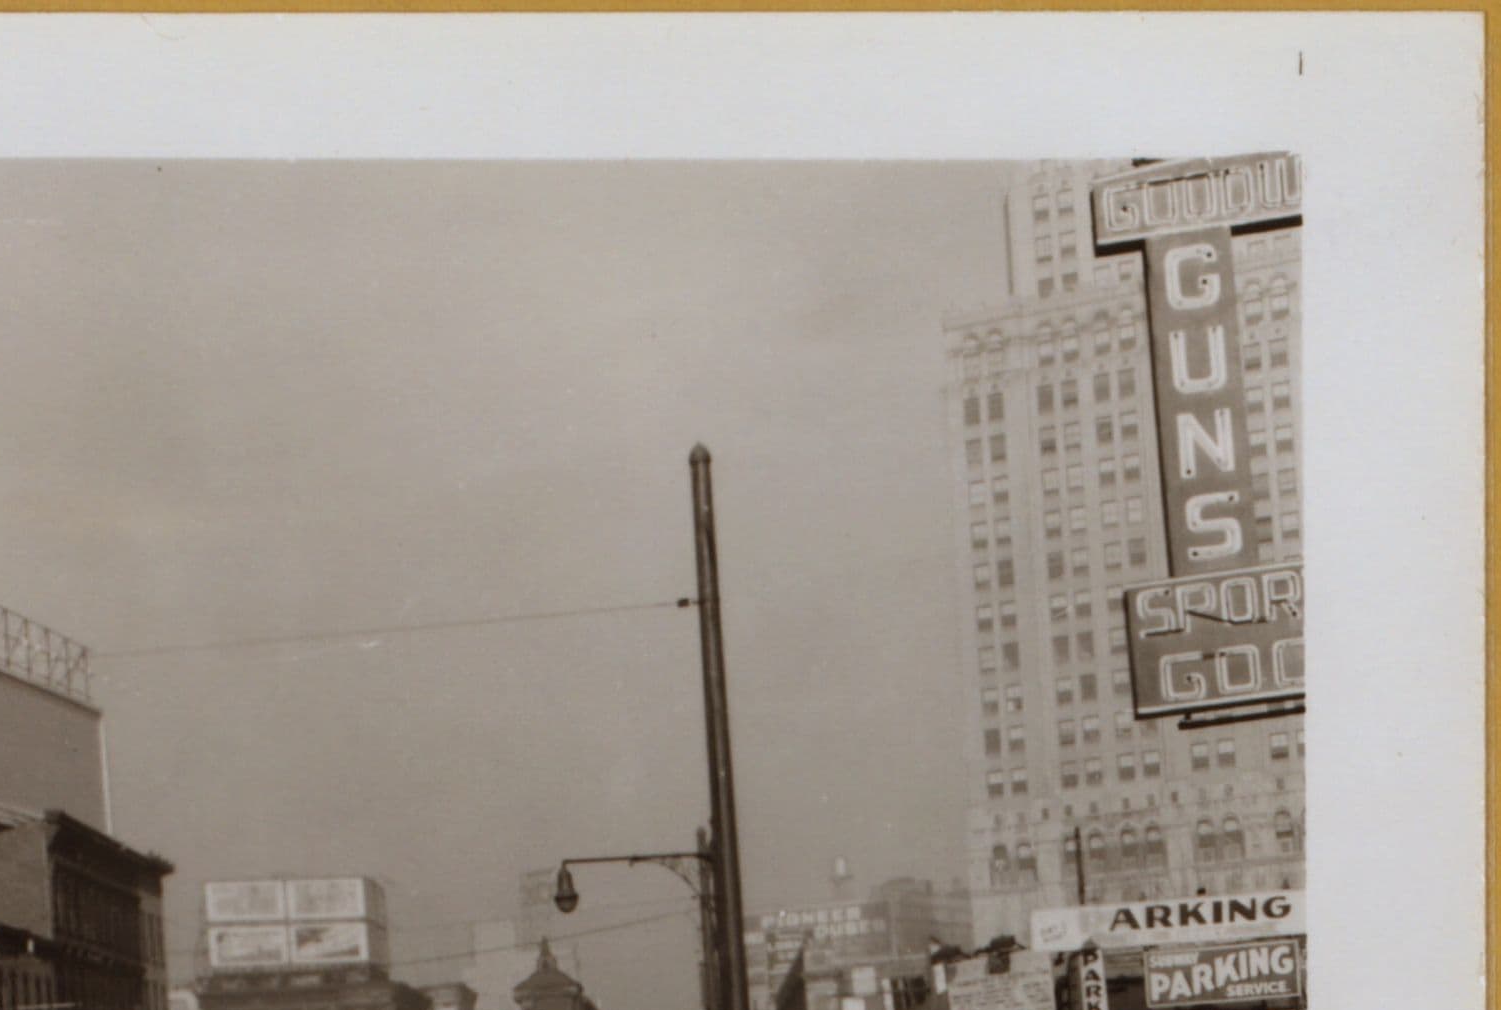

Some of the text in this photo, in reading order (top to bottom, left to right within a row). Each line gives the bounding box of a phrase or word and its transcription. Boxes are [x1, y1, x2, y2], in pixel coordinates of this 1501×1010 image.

[1162, 243, 1243, 561] GUNS
[1109, 896, 1292, 931] ARKING
[1150, 945, 1295, 1002] PARKING
[1226, 980, 1288, 998] SERVICE
